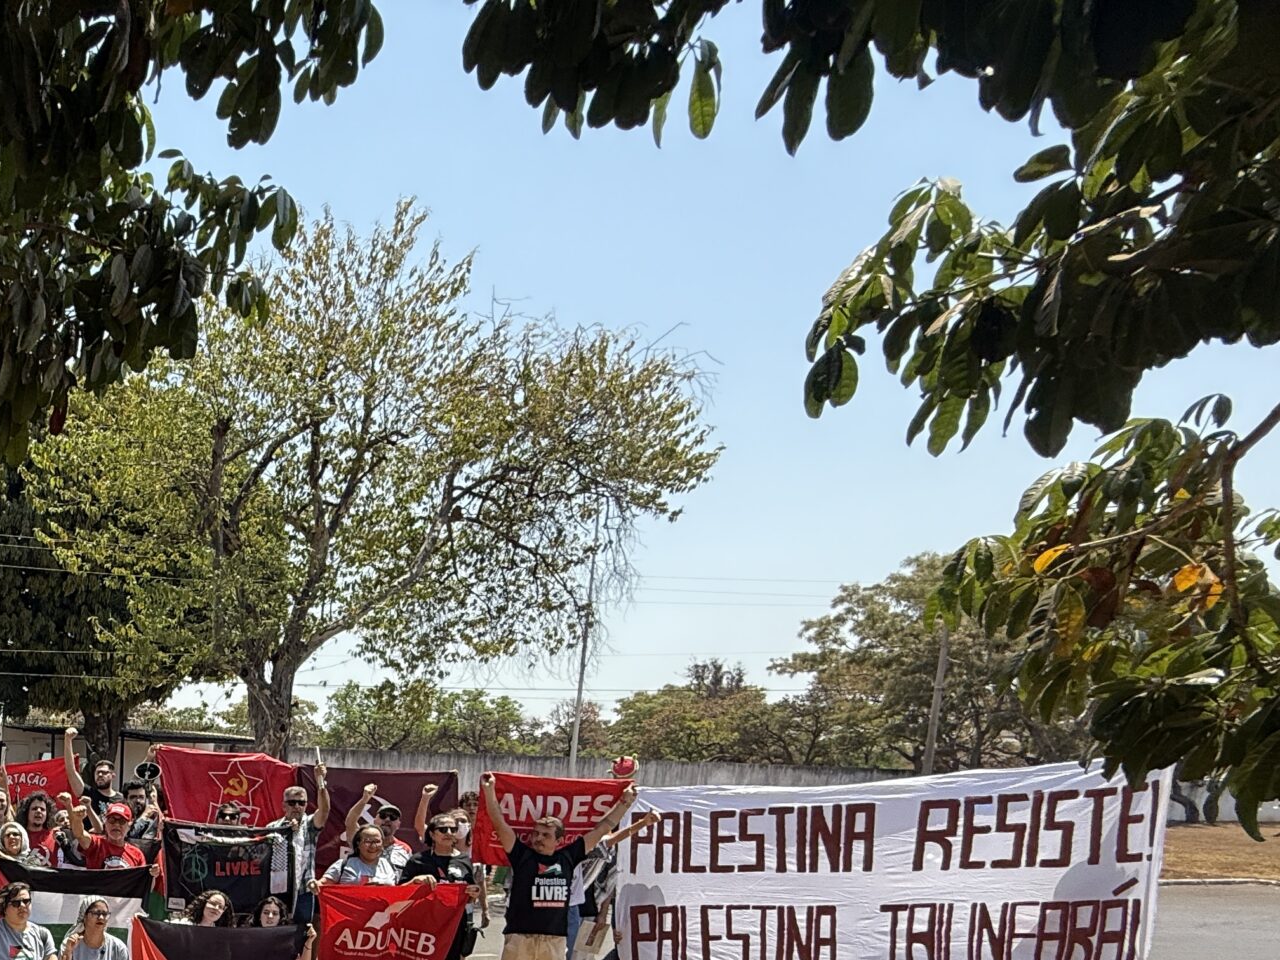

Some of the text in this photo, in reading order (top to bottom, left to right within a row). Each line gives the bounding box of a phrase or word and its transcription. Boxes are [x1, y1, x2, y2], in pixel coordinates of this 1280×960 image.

[500, 793, 615, 823] ANDES
[630, 779, 1160, 874] PALESTINA RESISTE!
[215, 861, 261, 878] LIVRE
[534, 877, 567, 886] Palestina
[532, 886, 568, 900] LIVRE
[335, 928, 436, 956] ADUNEB
